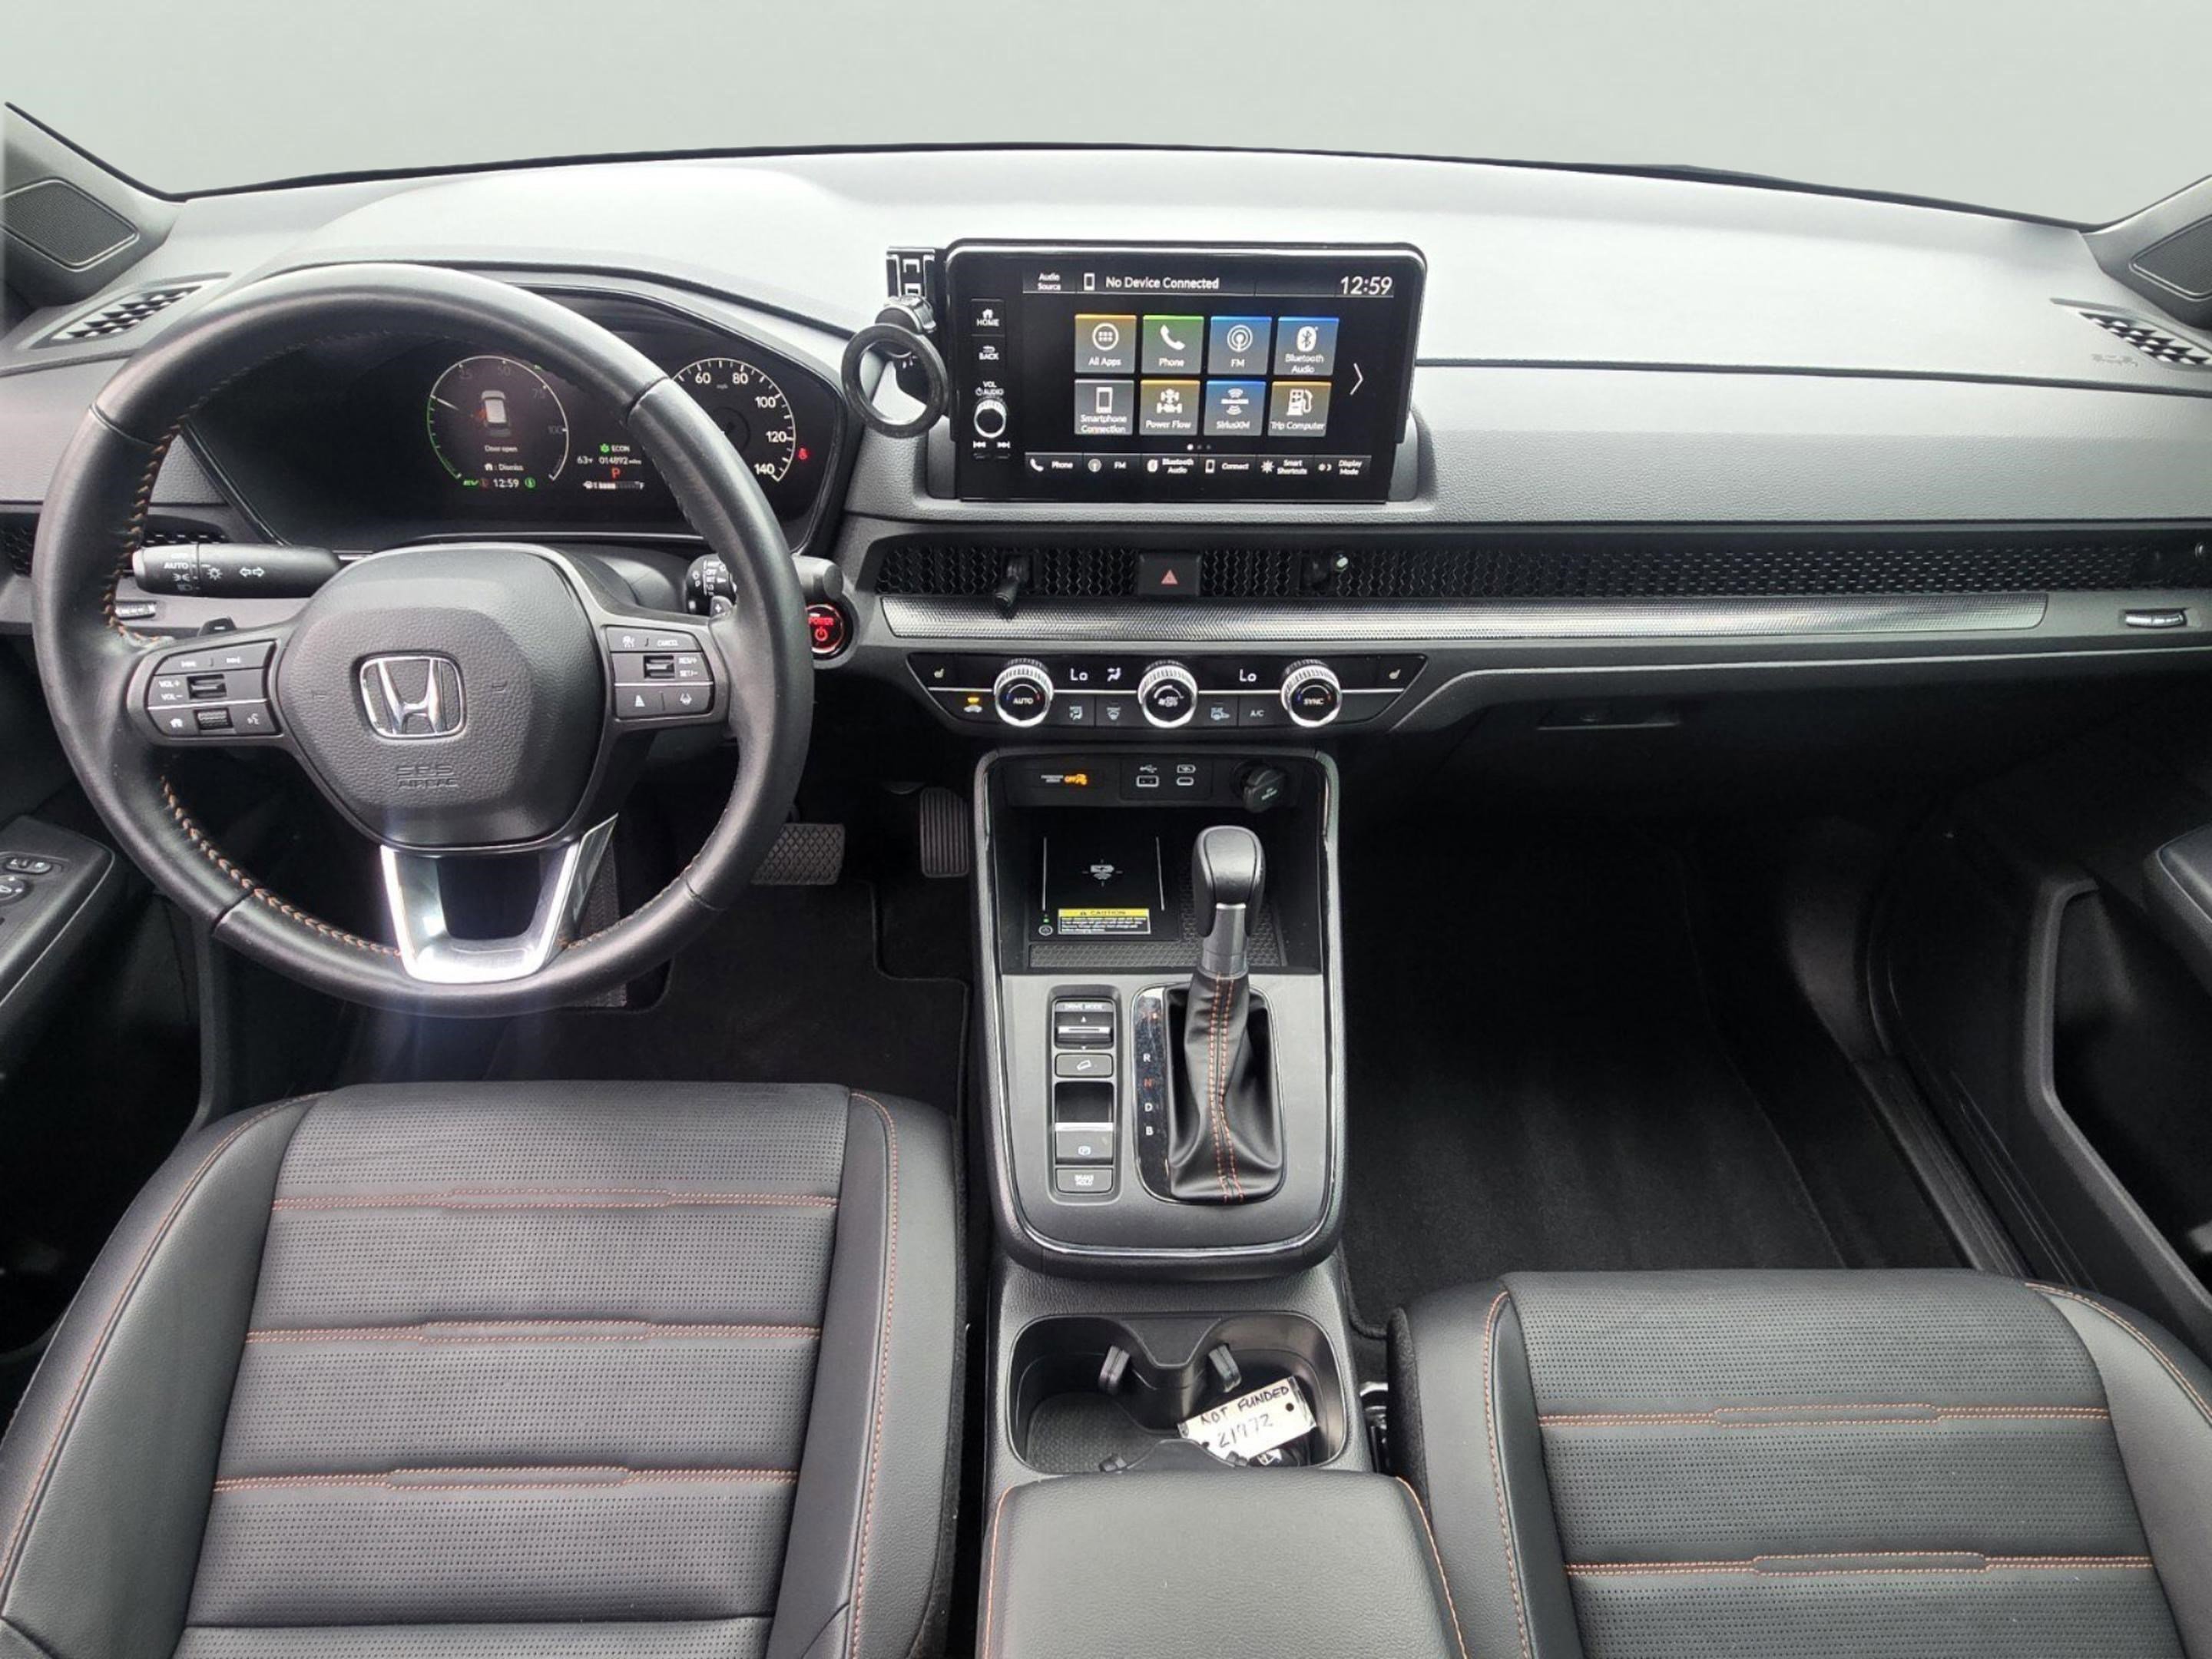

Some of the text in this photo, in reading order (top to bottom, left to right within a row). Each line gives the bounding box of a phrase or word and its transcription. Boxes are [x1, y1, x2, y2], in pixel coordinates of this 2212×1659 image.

[1106, 276, 1219, 289] No Device Connected
[1340, 276, 1392, 295] 12:59
[1088, 357, 1121, 368] All Apps
[1159, 357, 1184, 367] Phone
[1285, 353, 1324, 363] Bluetooth
[1231, 359, 1245, 368] FM
[1291, 365, 1315, 374] Audio
[695, 372, 711, 384] 60
[732, 372, 749, 384] 80
[754, 396, 776, 408] 100
[1081, 414, 1127, 424] Smartphone
[1081, 425, 1126, 434] Connection
[1146, 420, 1191, 429] Power Flow
[1216, 421, 1250, 430] SiriusXM
[1271, 422, 1326, 432] Trip Computer
[766, 431, 787, 442] 120
[611, 468, 621, 478] P
[753, 463, 775, 475] 140
[493, 478, 519, 489] 12:59
[808, 617, 833, 625] POWER
[1071, 667, 1088, 681] Lo
[1239, 669, 1257, 682] Lo
[1143, 1053, 1151, 1062] R
[1144, 1078, 1154, 1088] N
[1144, 1102, 1153, 1111] D
[1145, 1126, 1154, 1135] B
[1200, 1385, 1289, 1425] NOT FUNDED
